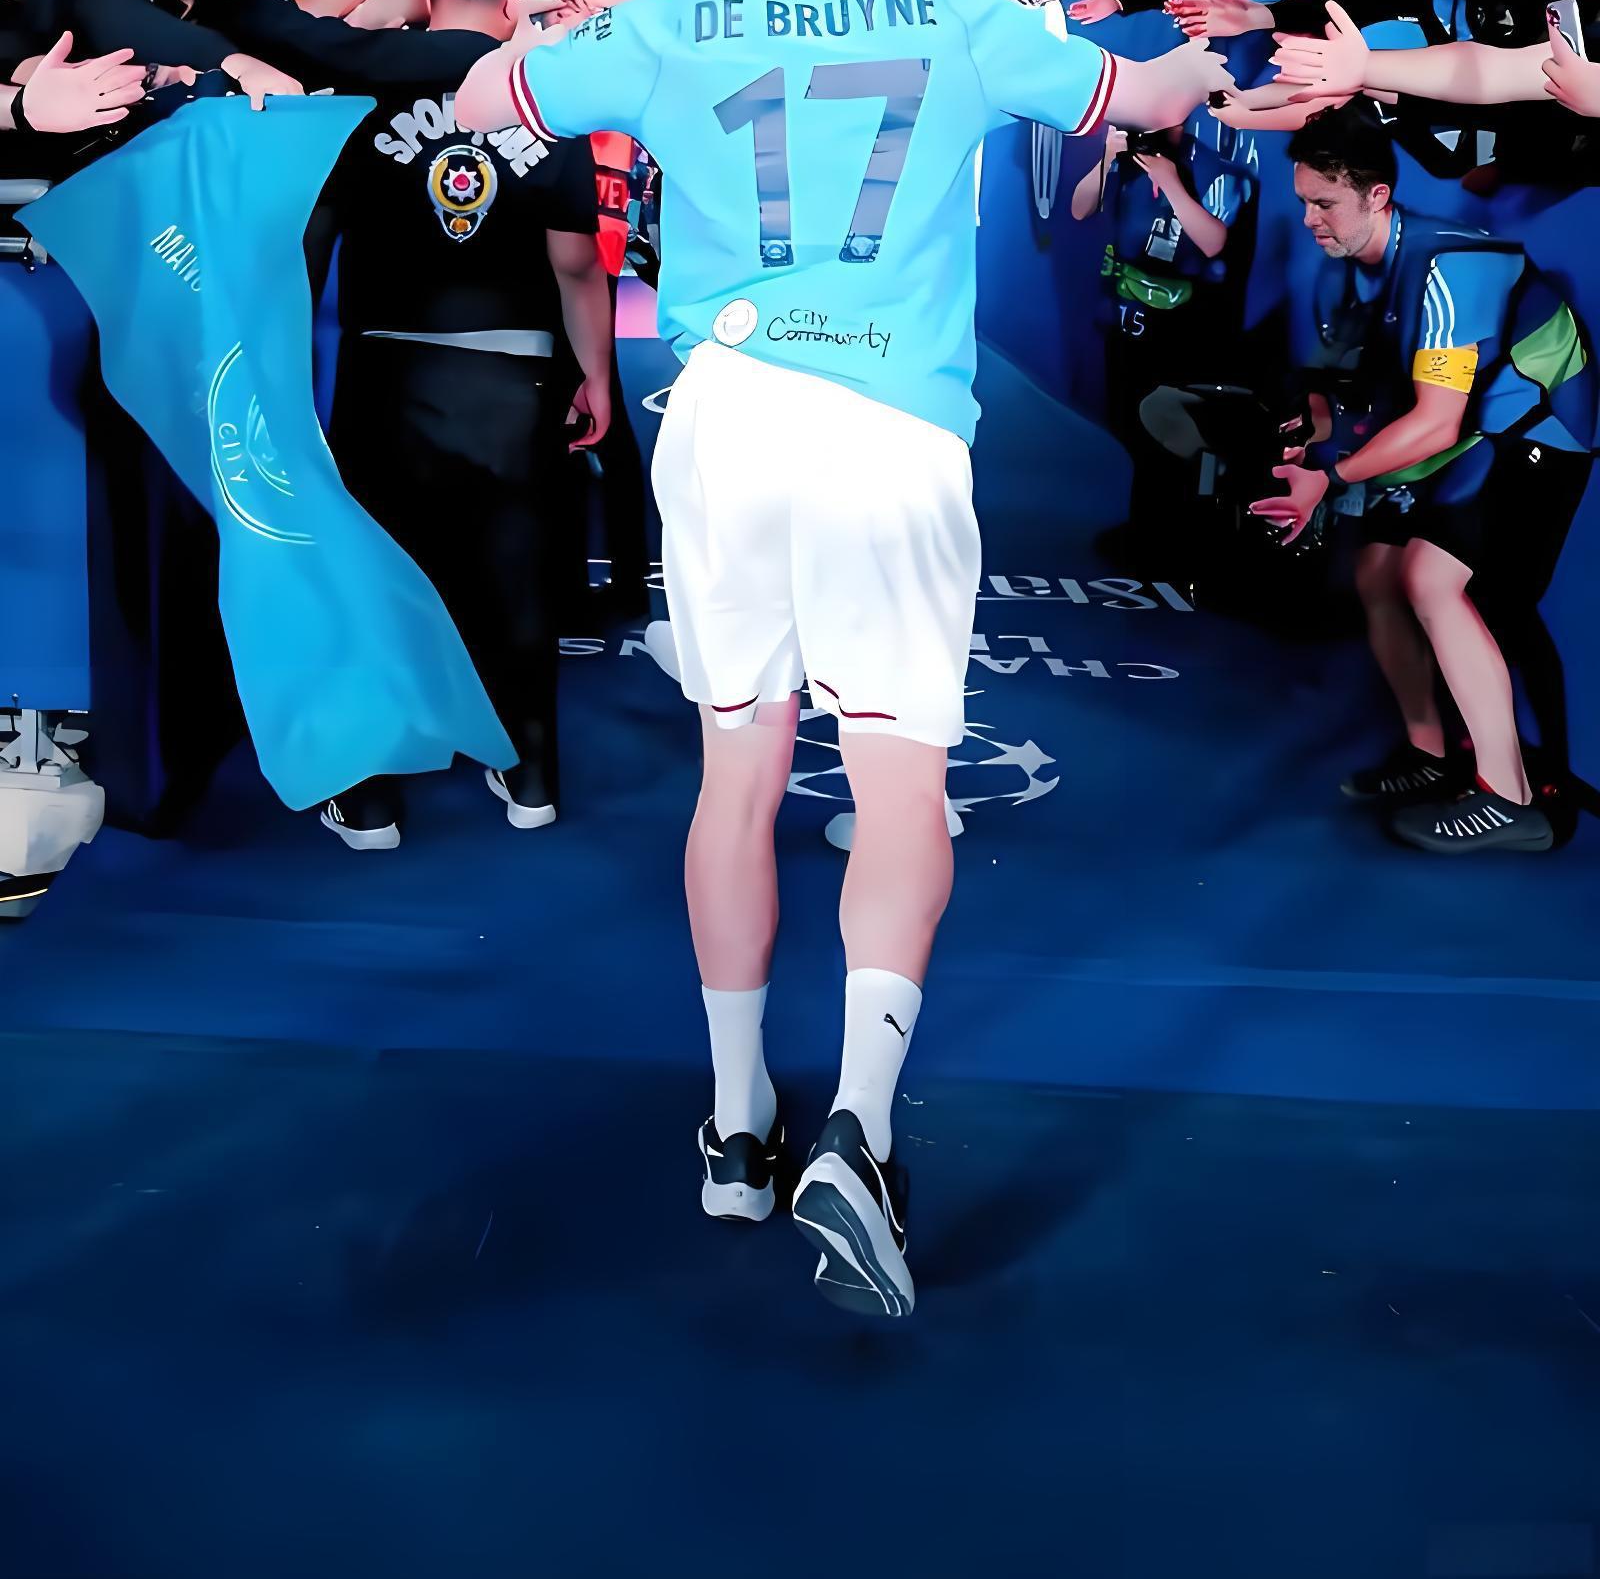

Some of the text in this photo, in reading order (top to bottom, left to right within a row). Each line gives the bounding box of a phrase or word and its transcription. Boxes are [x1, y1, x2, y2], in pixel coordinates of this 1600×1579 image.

[694, 0, 744, 43] DE
[712, 58, 932, 268] 17
[969, 654, 1180, 680] CHA
